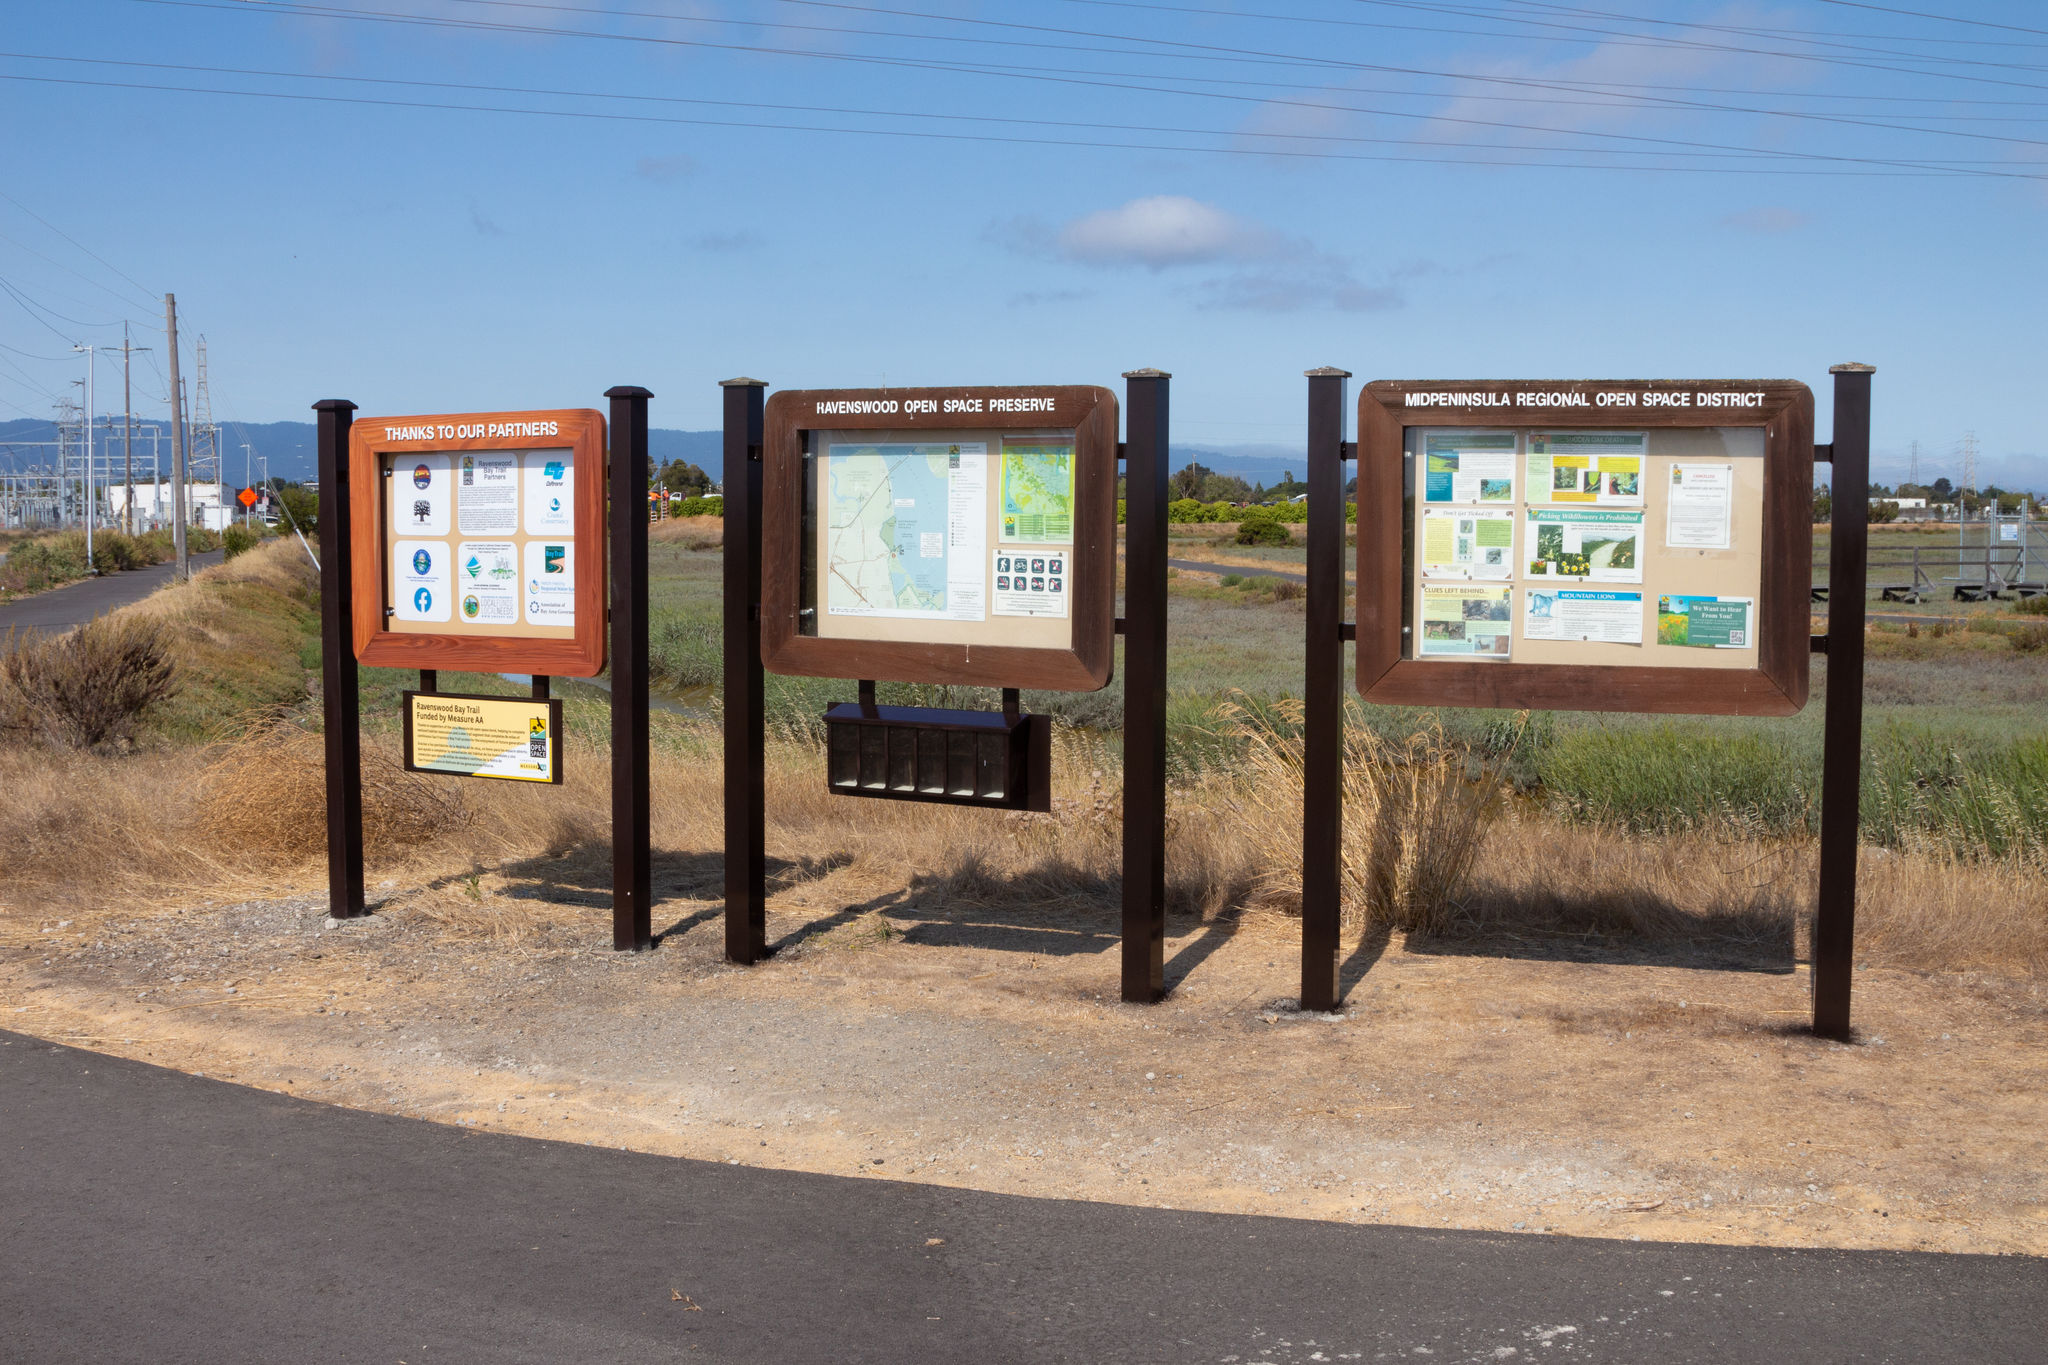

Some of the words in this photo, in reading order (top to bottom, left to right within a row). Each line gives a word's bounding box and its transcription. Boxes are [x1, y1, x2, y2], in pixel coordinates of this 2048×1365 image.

[816, 400, 899, 414] RAVENSWOOD
[904, 399, 938, 413] OPEN
[943, 398, 983, 413] SPACE
[988, 397, 1055, 412] PRESERVE
[1404, 392, 1511, 407] MIDPENINSULA
[1516, 392, 1591, 407] REGIONAL
[1595, 392, 1637, 407] OPEN
[1642, 392, 1691, 407] SPACE
[1696, 392, 1766, 407] DISTRICT
[384, 425, 436, 441] THANKS
[437, 424, 455, 440] TO
[457, 423, 486, 439] OUR
[488, 420, 559, 438] PARTNERS
[484, 467, 494, 475] Bay
[1538, 512, 1561, 521] Picking
[1562, 513, 1599, 521] Wildflowers
[1605, 514, 1639, 522] Prohibited
[416, 702, 453, 713] Ravenswood
[454, 704, 466, 715] Bay
[466, 705, 481, 714] Trail
[416, 711, 438, 721] Funded
[439, 712, 447, 723] by
[447, 714, 474, 723] Measure
[475, 716, 484, 724] AA
[530, 744, 546, 752] OPEN
